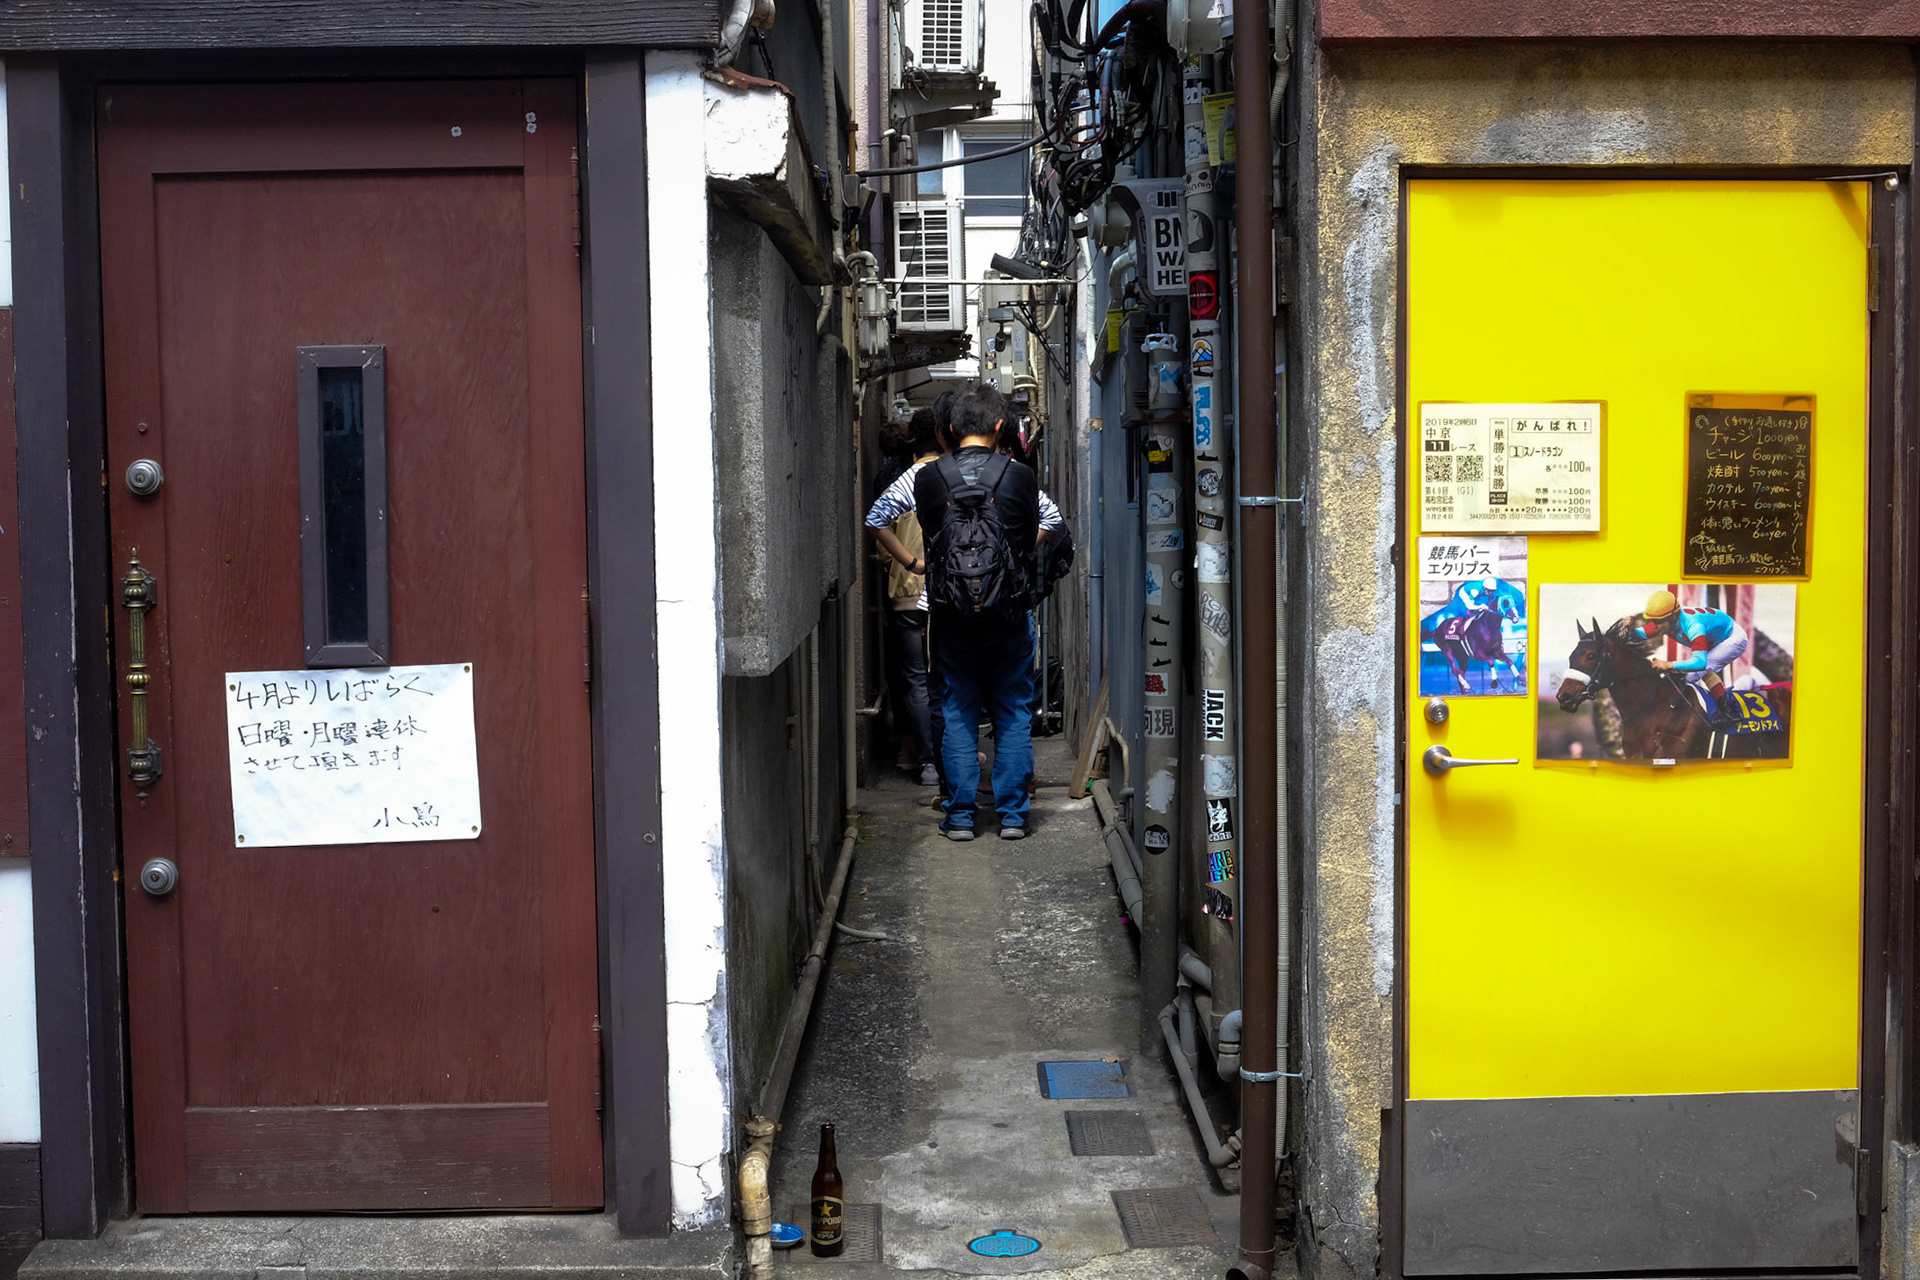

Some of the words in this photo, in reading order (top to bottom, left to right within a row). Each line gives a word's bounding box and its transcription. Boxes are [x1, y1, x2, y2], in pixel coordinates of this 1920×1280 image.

[1155, 217, 1184, 249] BN
[1157, 251, 1187, 267] WA
[1157, 270, 1187, 286] HE
[1706, 448, 1746, 460] ビール
[1707, 465, 1741, 479] 焼酎
[1707, 482, 1746, 495] カクテル
[1428, 545, 1490, 560] 競馬バー
[1428, 560, 1492, 576] エクリプス
[1448, 620, 1460, 634] 5
[1732, 692, 1771, 719] 13
[1206, 690, 1224, 740] JACK
